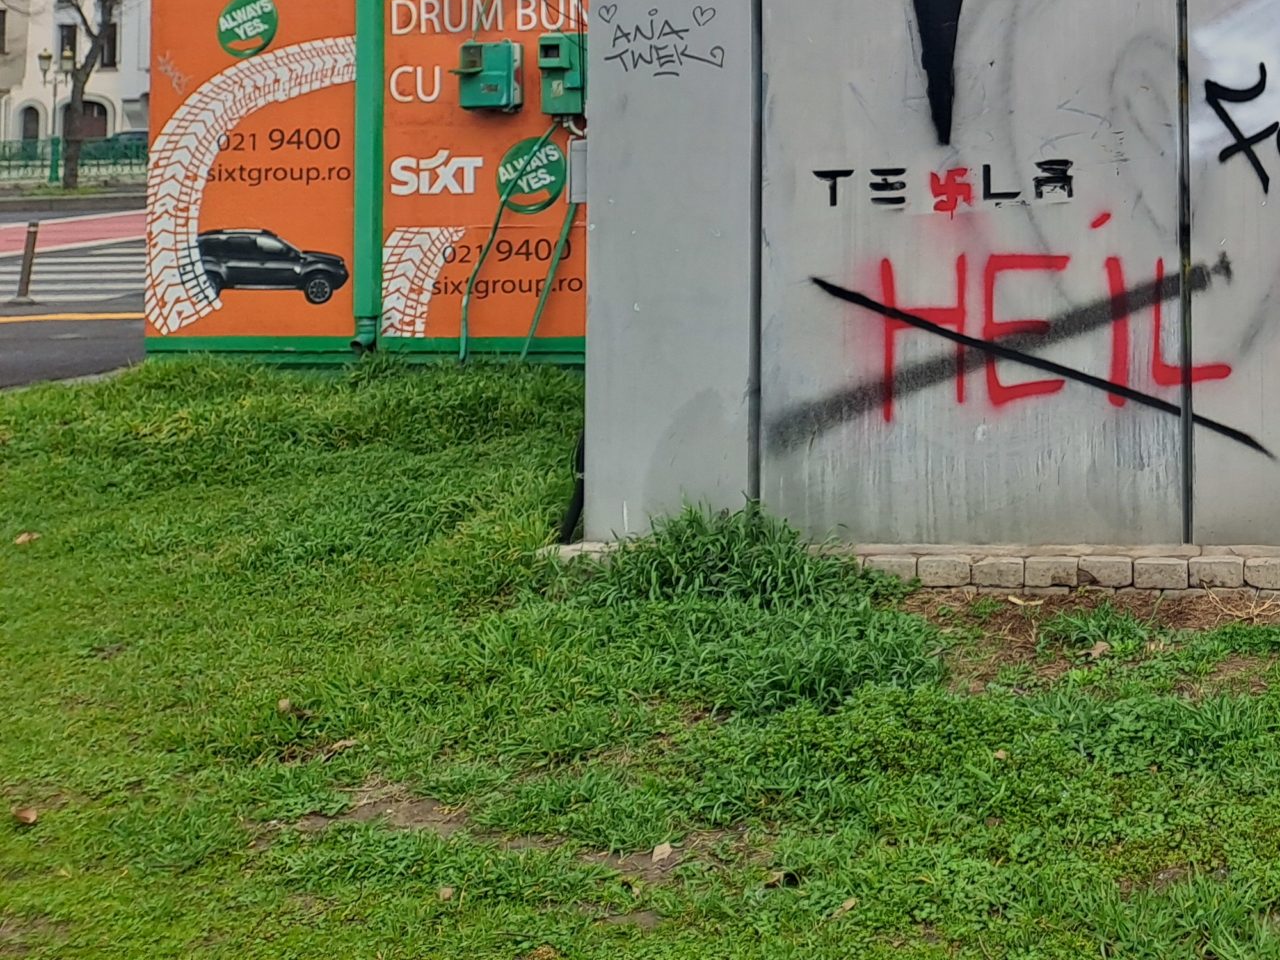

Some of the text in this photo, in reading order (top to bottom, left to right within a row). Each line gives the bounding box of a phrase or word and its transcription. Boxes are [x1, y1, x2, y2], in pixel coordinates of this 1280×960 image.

[390, 65, 441, 103] CU
[217, 128, 341, 152] 021 9400
[206, 163, 351, 187] sixtgroup.ro
[498, 145, 560, 184] ALWAYS
[441, 238, 572, 264] 021 9400
